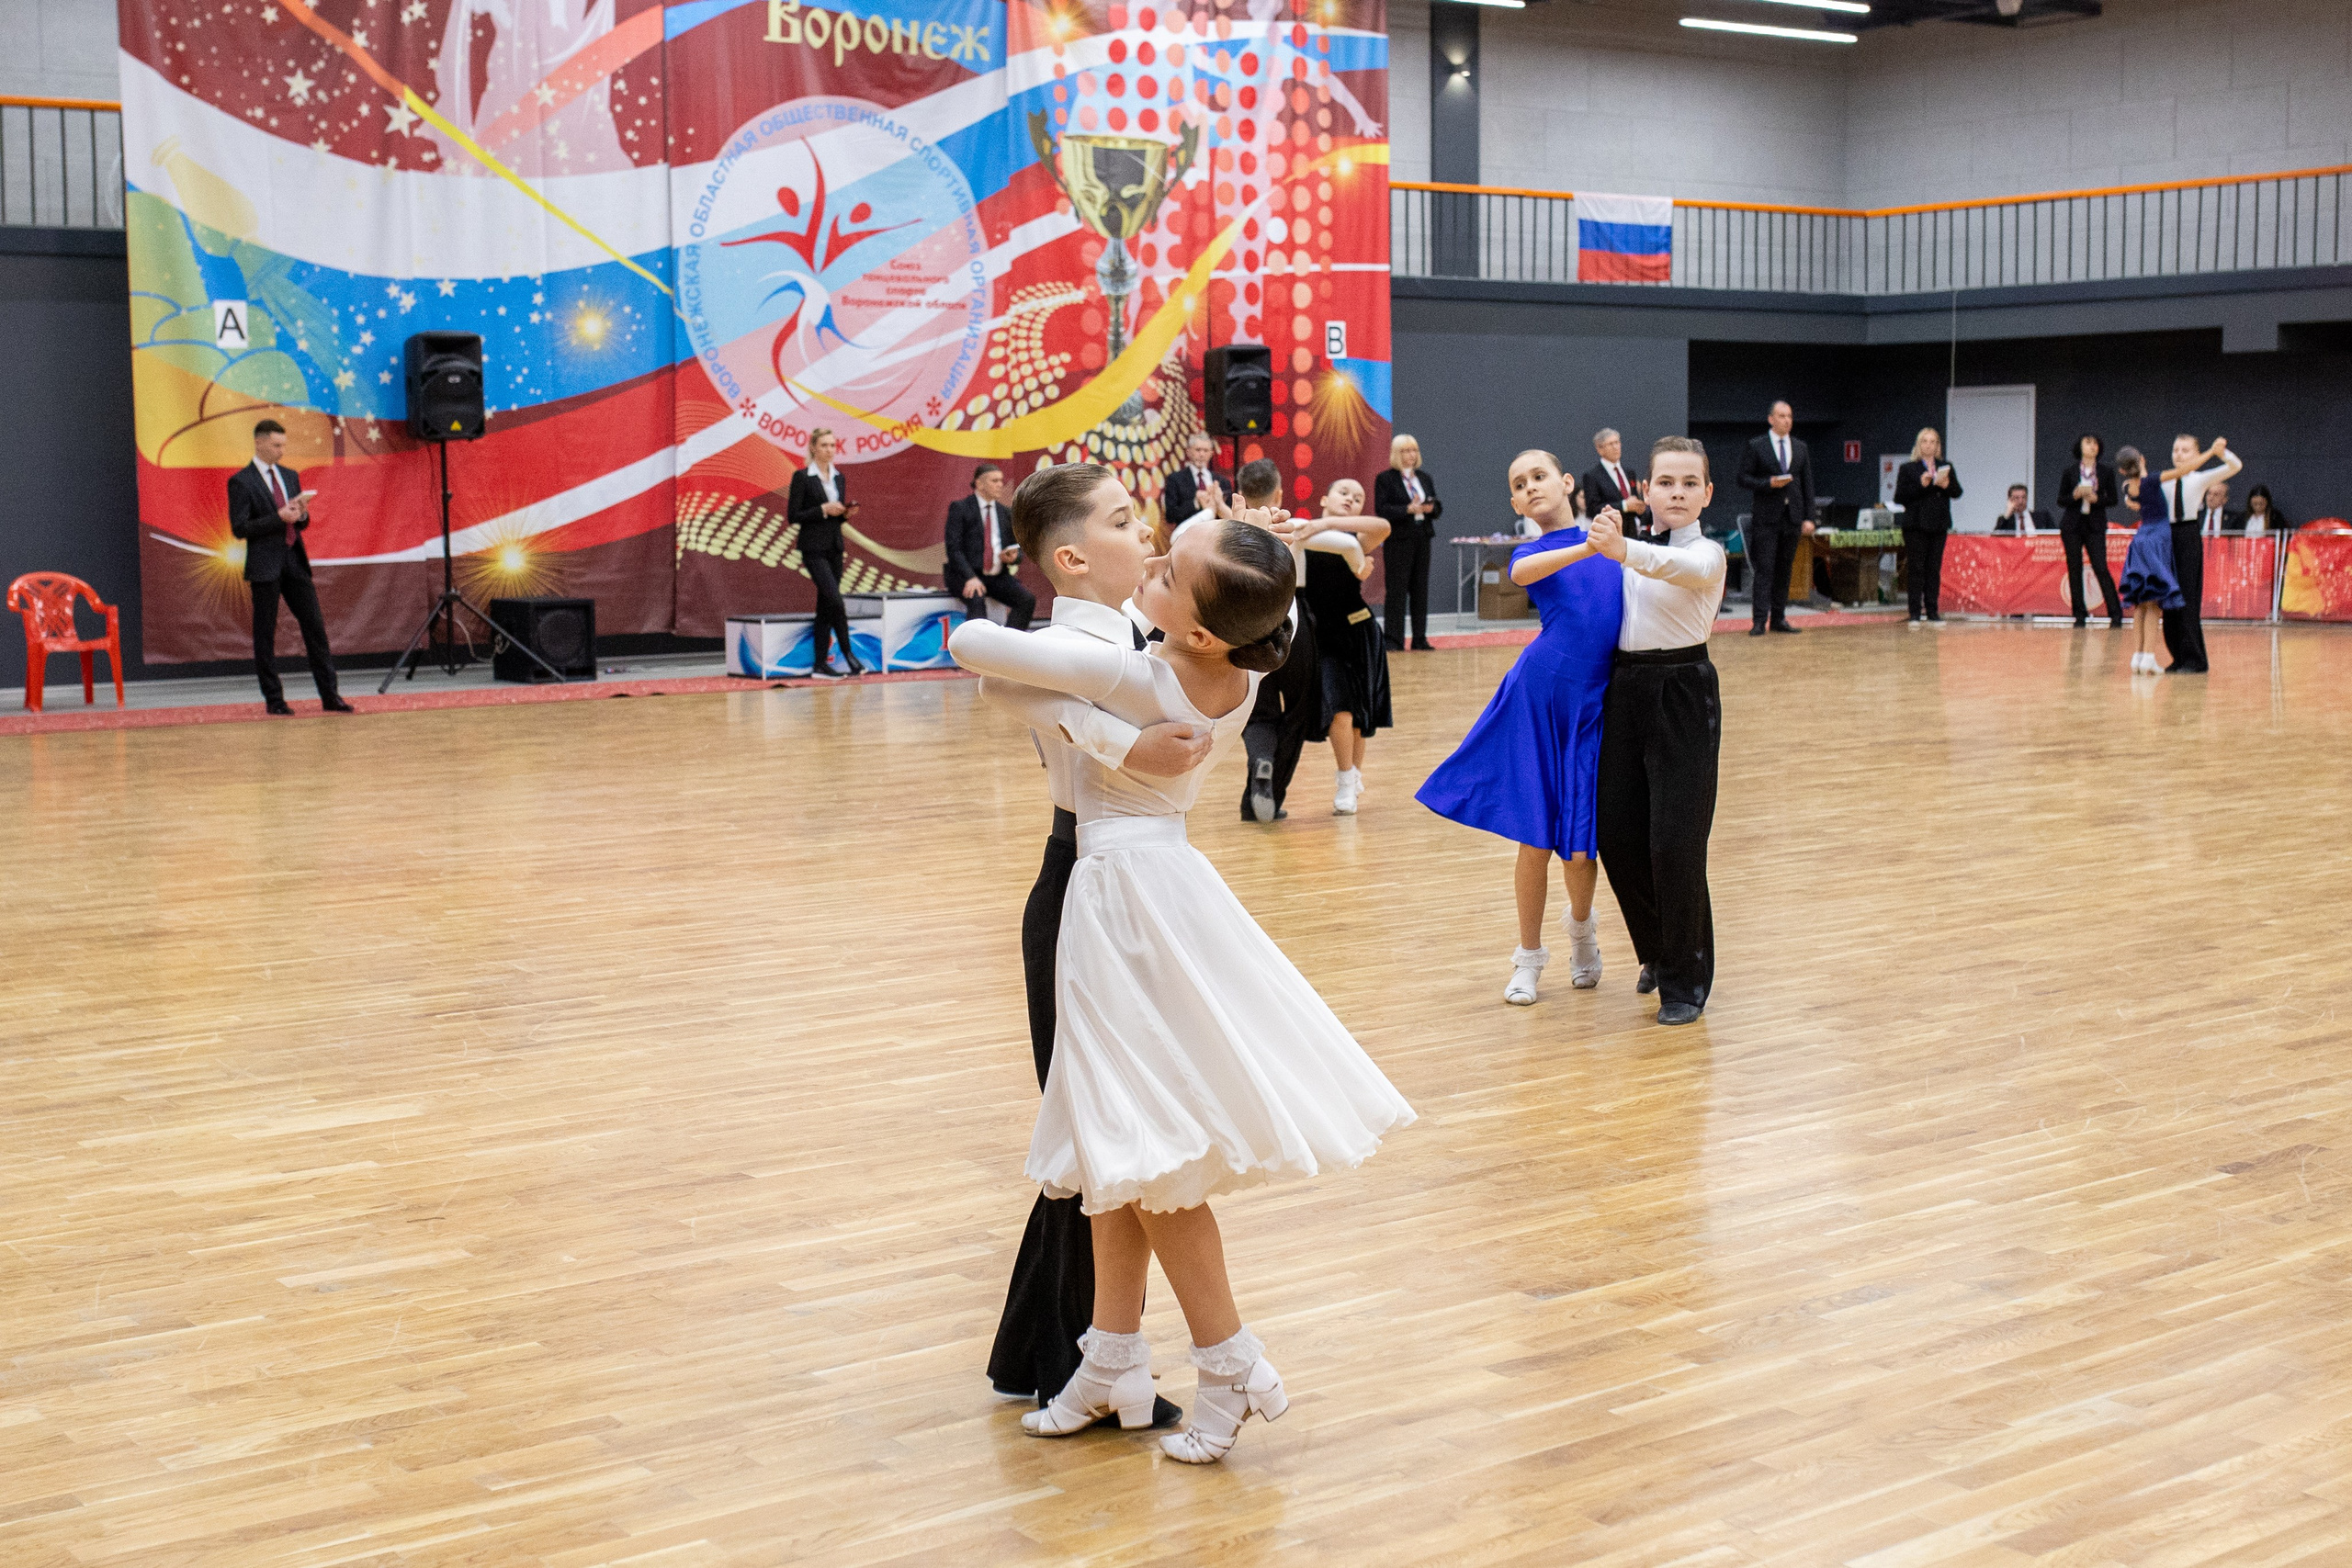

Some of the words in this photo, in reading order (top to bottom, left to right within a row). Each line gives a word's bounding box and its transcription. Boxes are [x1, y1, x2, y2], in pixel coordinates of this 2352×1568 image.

[763, 0, 991, 68] Воронеж
[759, 104, 909, 141] ОБЩЕСТВЕННАЯ
[689, 129, 758, 238] ОБЛАСТНАЯ
[909, 136, 980, 254] СПОРТИВНАЯ
[684, 243, 741, 399] ВОРОНЕЖСКАЯ
[940, 260, 986, 400] ОРГАНИЗАЦИЯ
[855, 412, 923, 454] РОССИЯ
